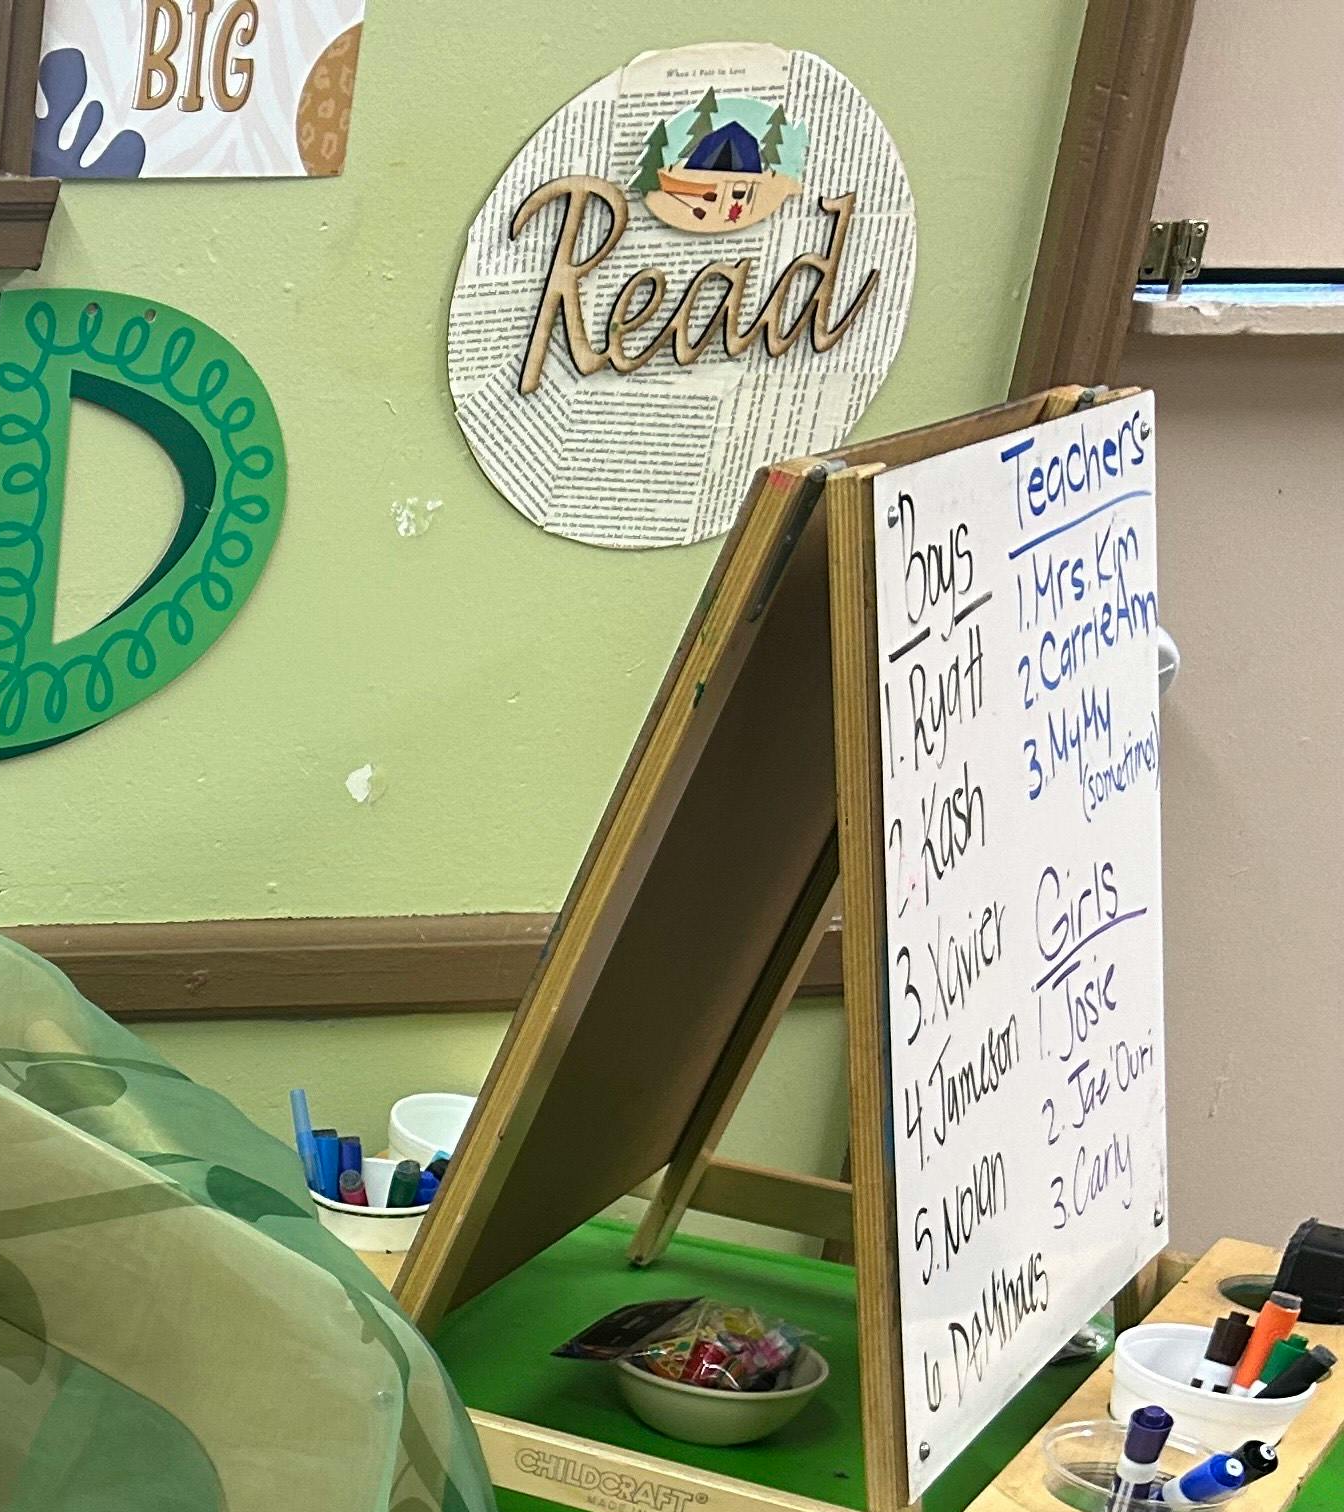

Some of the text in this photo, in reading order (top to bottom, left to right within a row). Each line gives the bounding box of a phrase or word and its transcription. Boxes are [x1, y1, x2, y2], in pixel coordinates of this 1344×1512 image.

[132, 0, 258, 112] BIG
[510, 174, 879, 396] Read
[1001, 411, 1144, 530] Teachers
[898, 490, 973, 642] Boys
[1032, 552, 1091, 625] Mrs.
[1095, 524, 1139, 589] Kim
[921, 760, 985, 906] Kash
[928, 900, 1005, 1024] Xavier
[1036, 862, 1118, 961] Girls
[1053, 955, 1117, 1061] Josie
[928, 1013, 1020, 1146] Jameson
[942, 1151, 1007, 1272] Nolan
[1074, 1133, 1133, 1216] Carly
[587, 1495, 626, 1512] MADE
